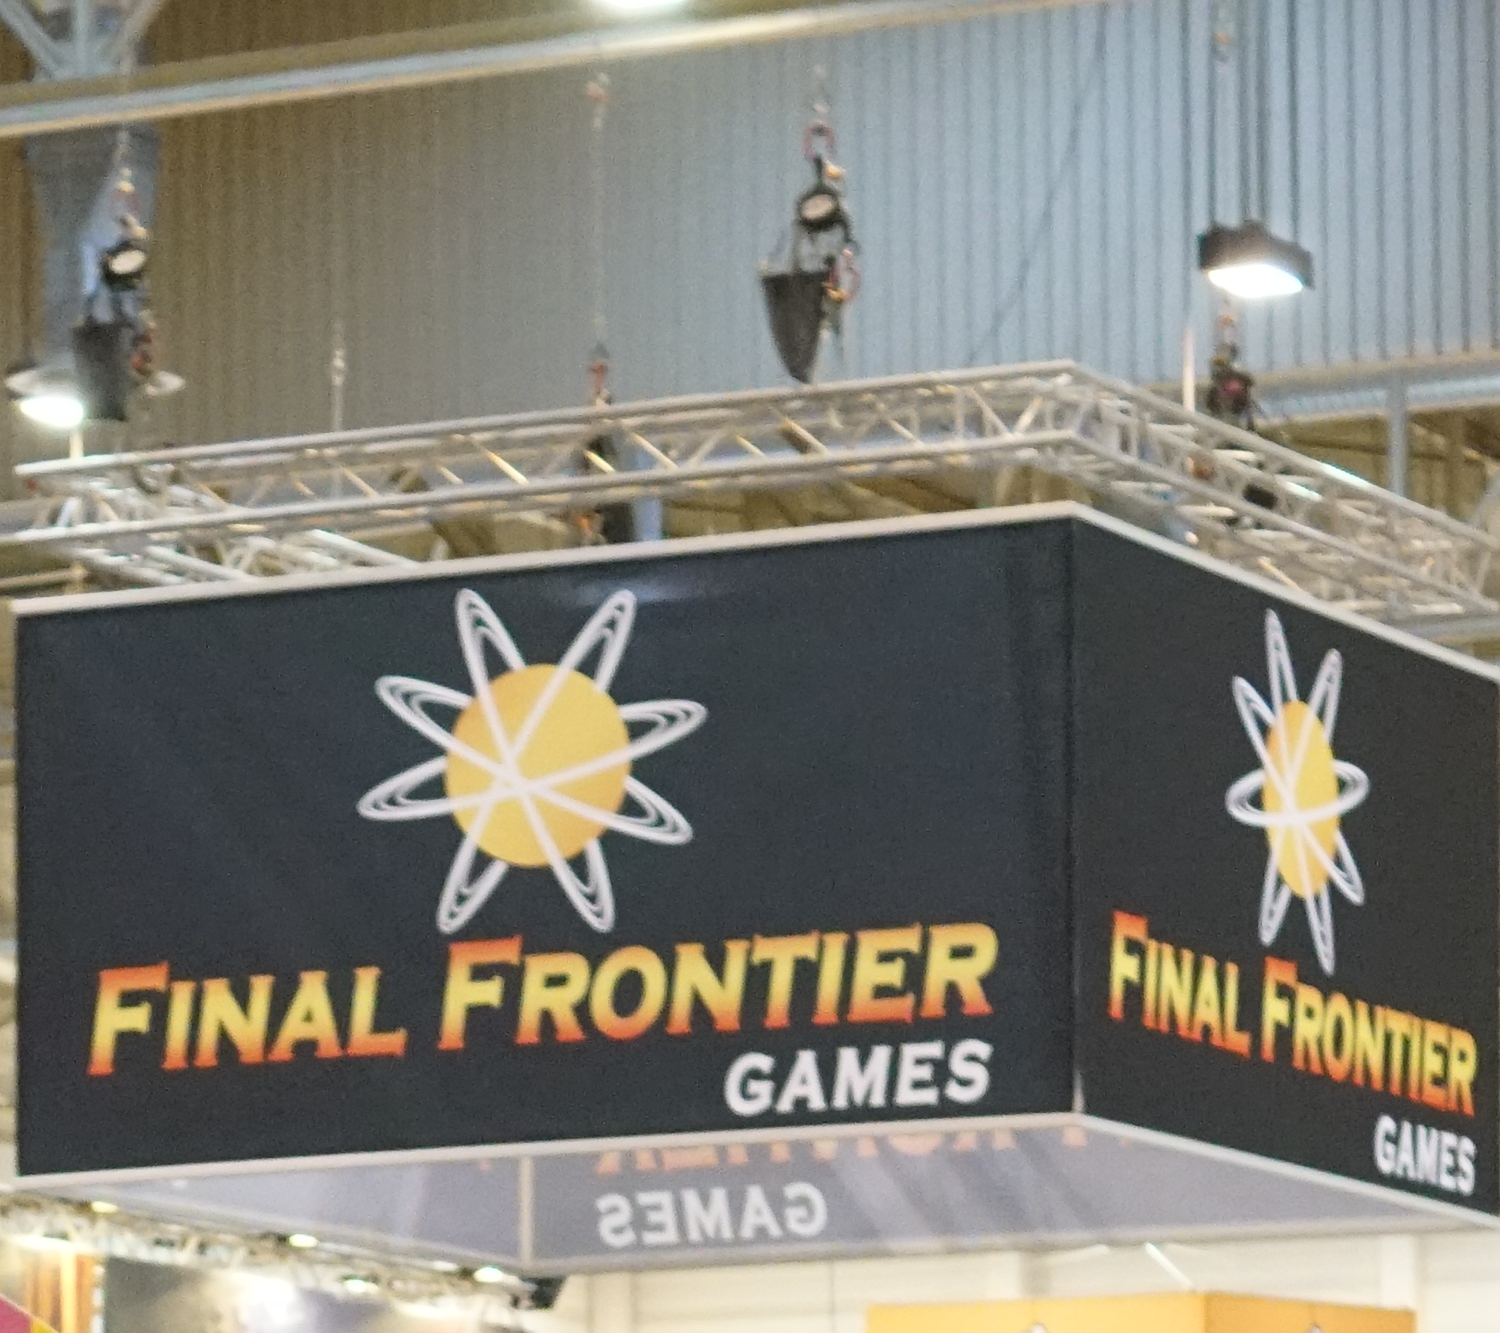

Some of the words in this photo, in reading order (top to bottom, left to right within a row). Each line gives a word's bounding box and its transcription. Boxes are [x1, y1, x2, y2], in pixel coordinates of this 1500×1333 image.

[87, 960, 408, 1077] FINAL
[436, 922, 999, 1052] FRONTIER
[1107, 908, 1252, 1060] FINAL
[1261, 955, 1478, 1119] FRONTIER
[725, 1039, 993, 1118] GAMES
[1373, 1113, 1478, 1197] GAMES
